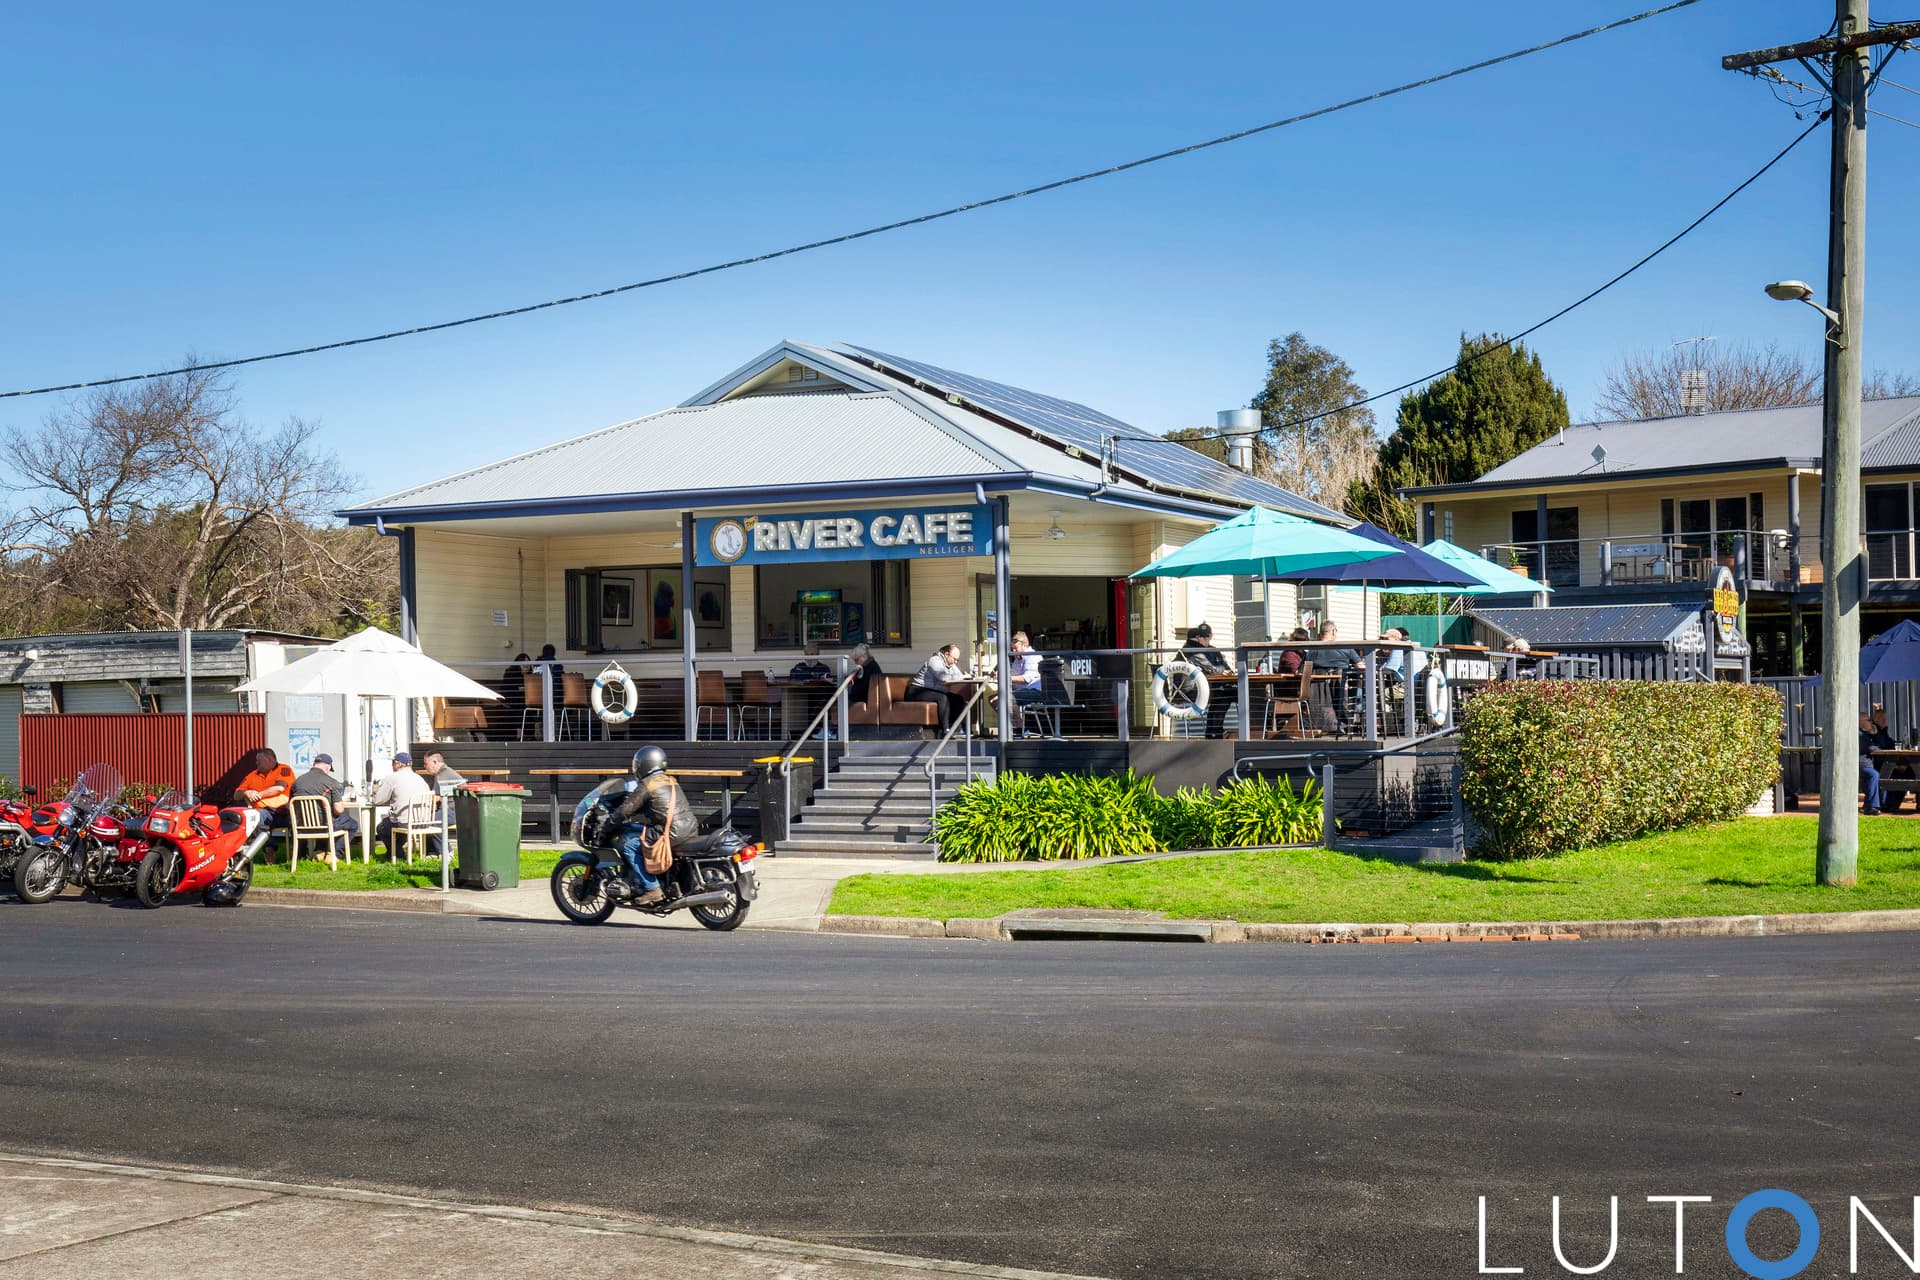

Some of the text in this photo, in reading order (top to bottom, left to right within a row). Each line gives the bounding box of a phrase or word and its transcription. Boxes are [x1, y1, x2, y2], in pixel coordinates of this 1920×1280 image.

[754, 518, 865, 551] RIVER
[870, 512, 974, 546] CAFE
[919, 545, 974, 555] NELLIGEN
[1071, 659, 1092, 675] OPEN
[189, 854, 216, 873] DUCATI
